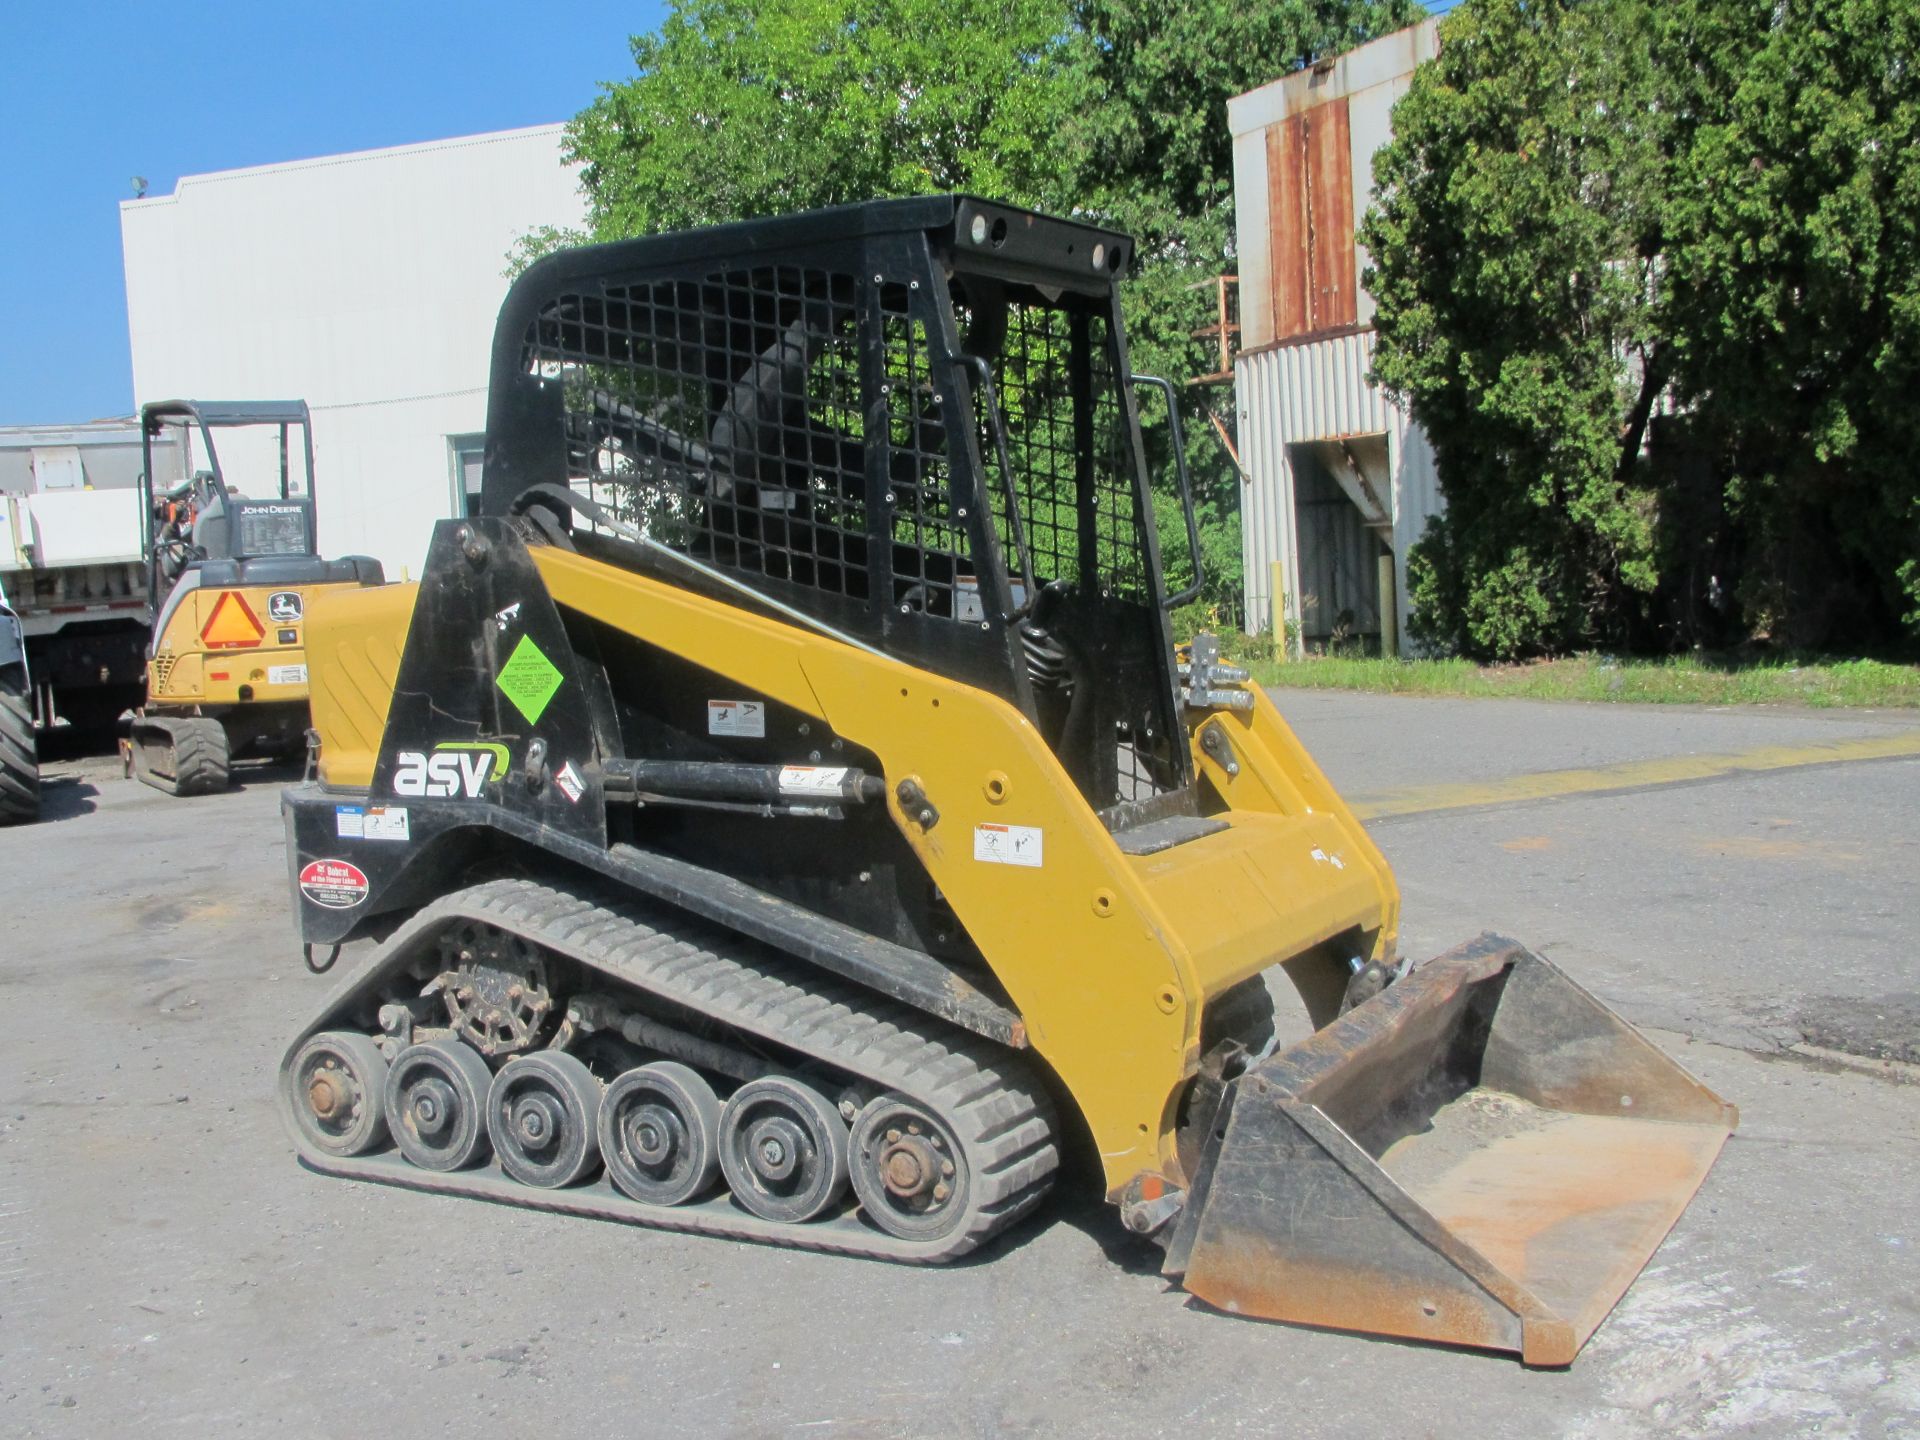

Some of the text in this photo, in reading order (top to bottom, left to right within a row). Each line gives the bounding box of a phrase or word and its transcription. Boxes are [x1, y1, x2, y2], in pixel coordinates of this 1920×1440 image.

[241, 505, 302, 514] JOHN DEERE
[327, 866, 349, 877] Bobcat
